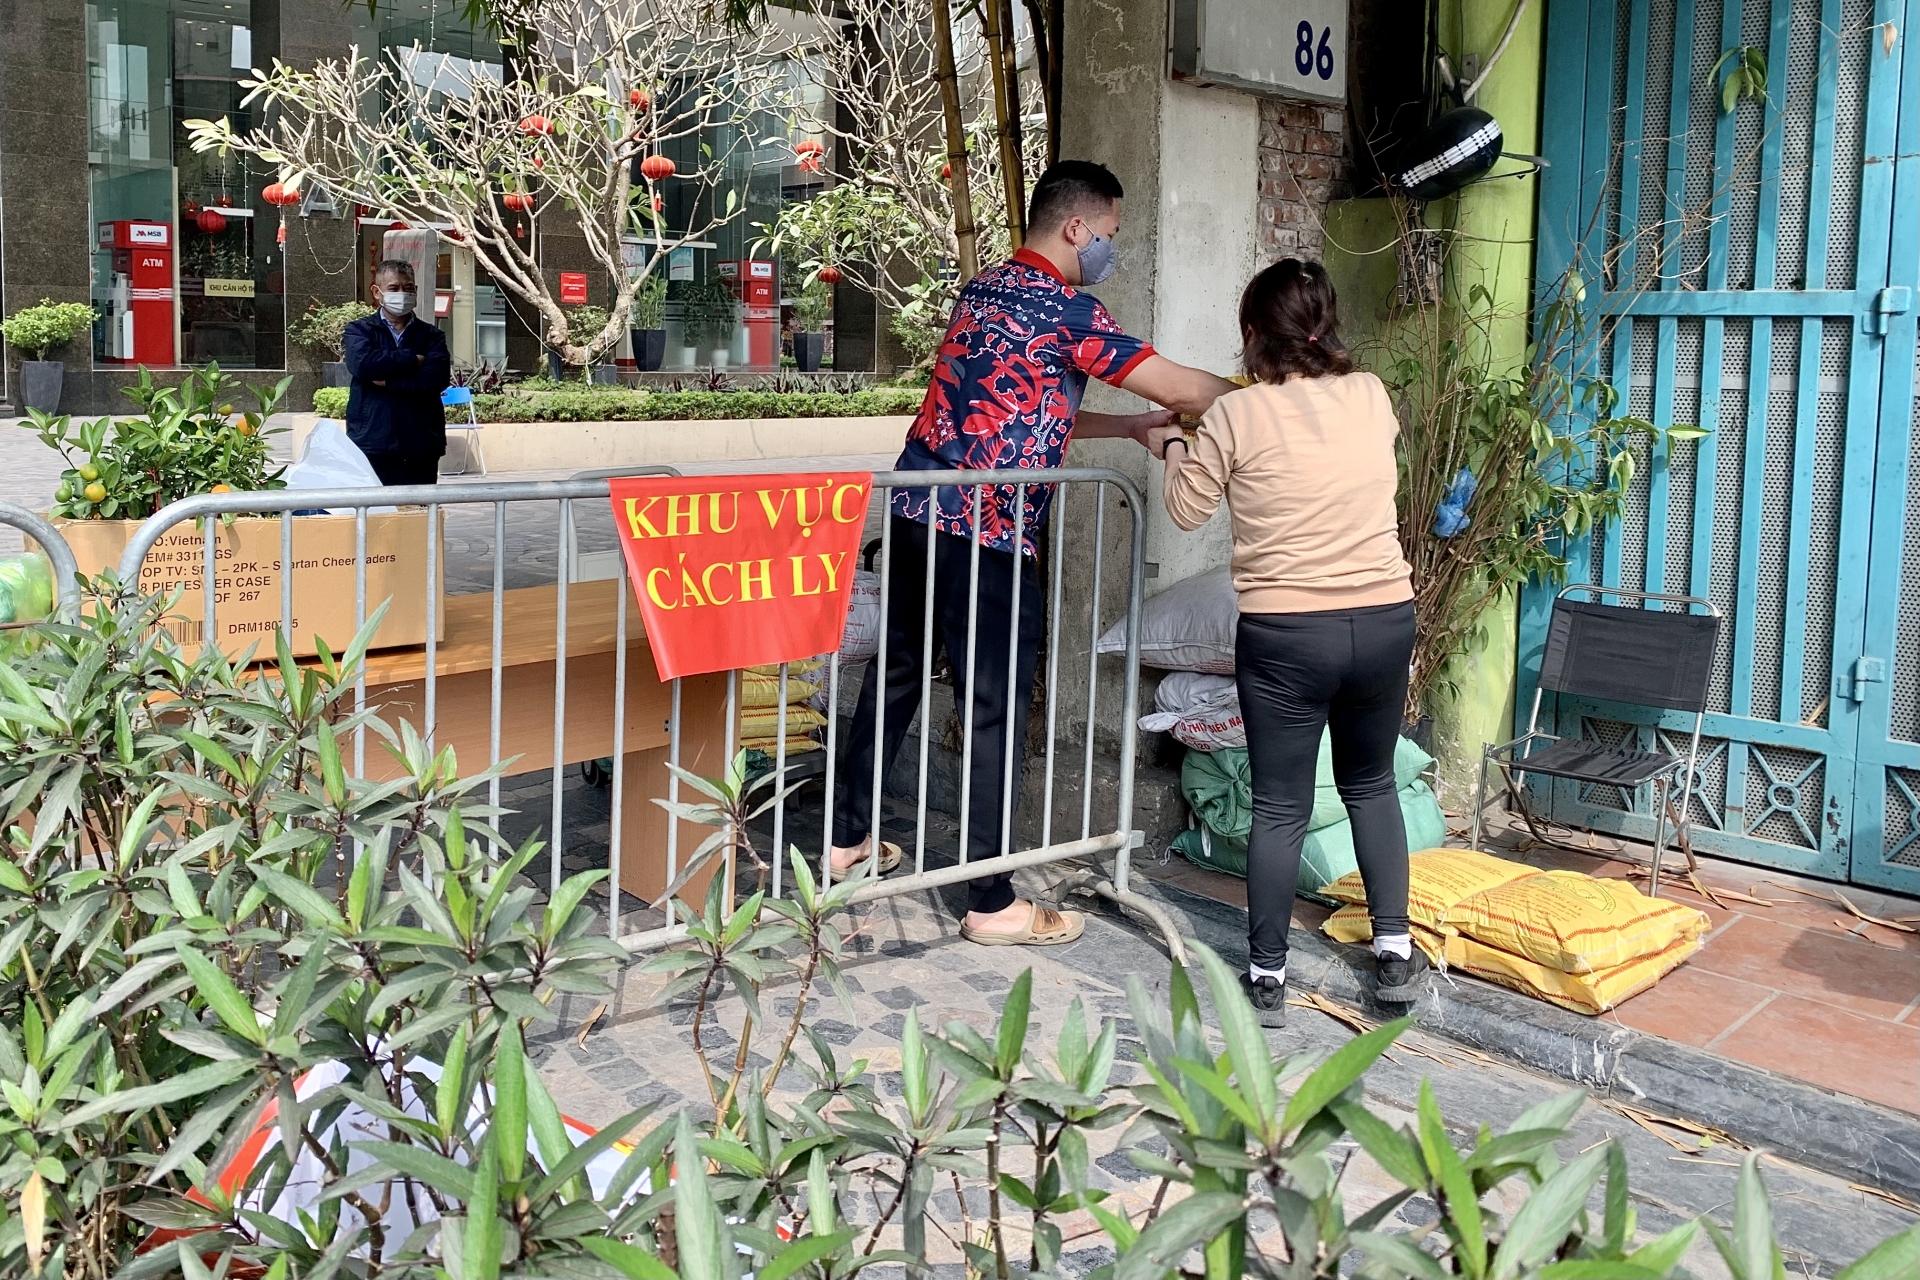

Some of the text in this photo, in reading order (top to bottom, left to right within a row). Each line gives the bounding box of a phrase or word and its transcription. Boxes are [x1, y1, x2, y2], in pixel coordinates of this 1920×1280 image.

[1295, 20, 1334, 81] 86
[142, 258, 163, 267] ATM
[621, 478, 864, 540] KHU VỰC
[146, 549, 232, 563] EM# 3311GS
[142, 567, 161, 578] OP
[165, 566, 187, 577] TV:
[233, 562, 258, 573] 2PK
[272, 559, 318, 571] Sartan
[322, 554, 396, 567] Cheeraders
[215, 578, 231, 588] ER
[235, 576, 271, 588] CASE
[646, 551, 848, 611] CÁCH LY
[239, 591, 261, 602] 267
